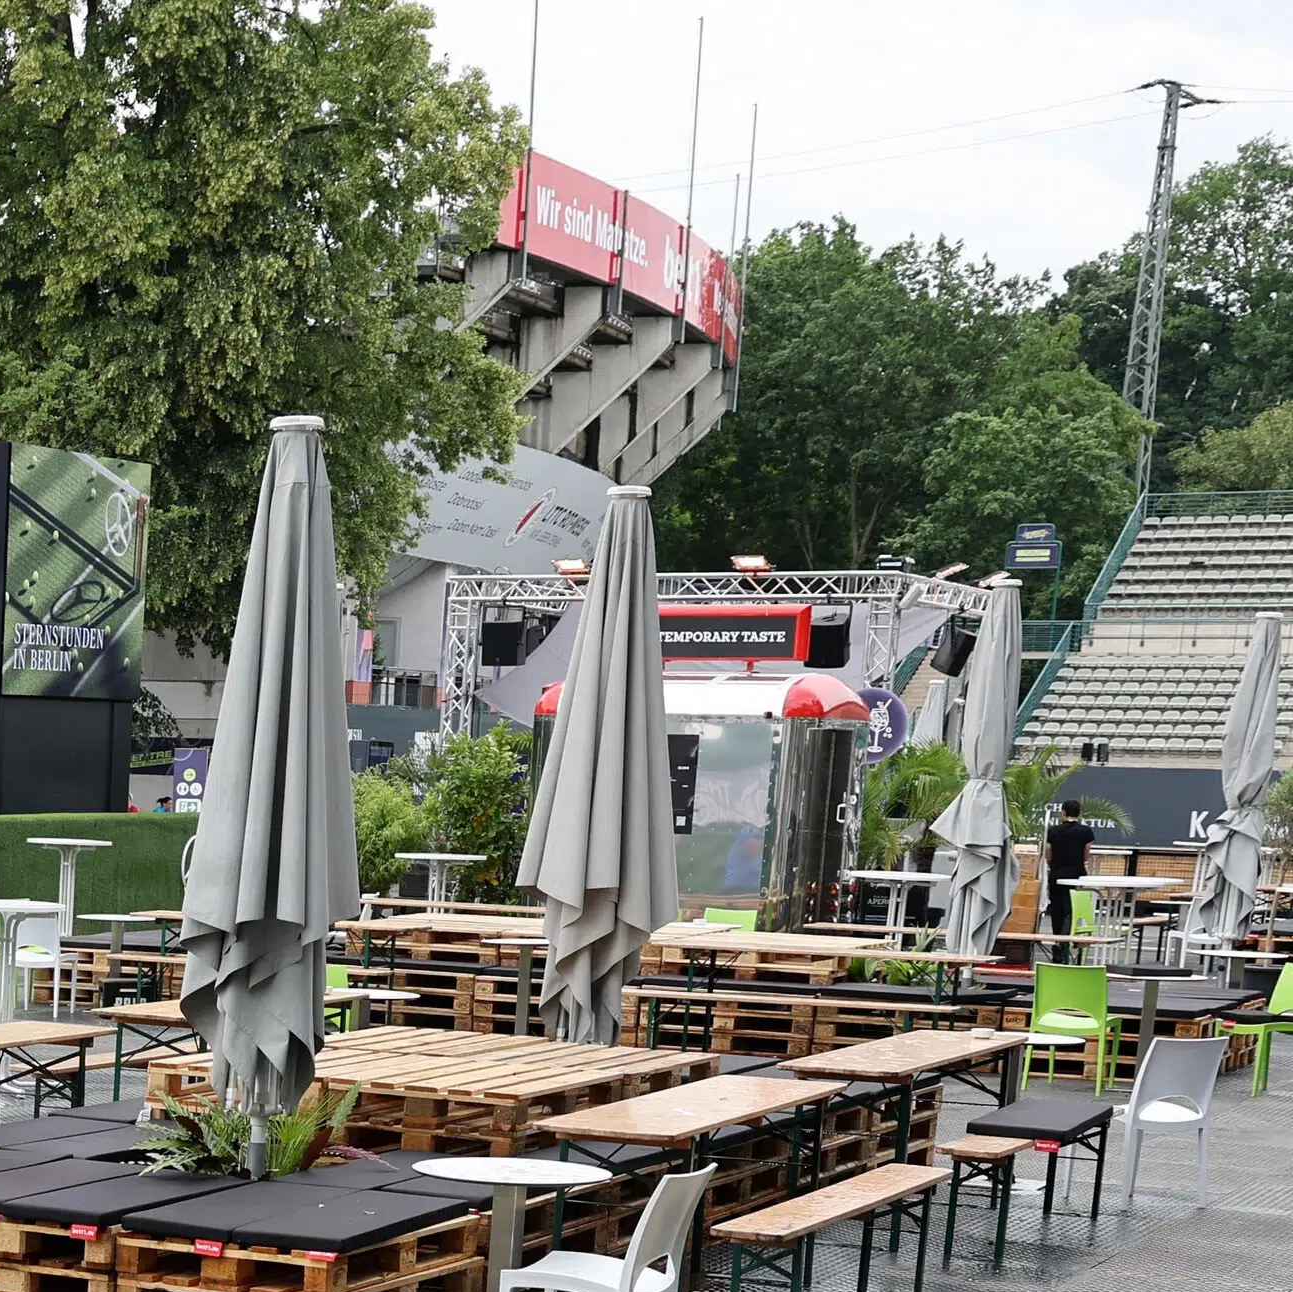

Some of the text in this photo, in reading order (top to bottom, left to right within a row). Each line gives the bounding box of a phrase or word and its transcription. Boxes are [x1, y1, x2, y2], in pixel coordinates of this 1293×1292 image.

[536, 184, 562, 230] Wir
[563, 197, 594, 243] sind
[13, 622, 105, 650] STERNSTUNDEN
[741, 631, 787, 643] TASTE
[13, 648, 73, 672] IN BERLIN
